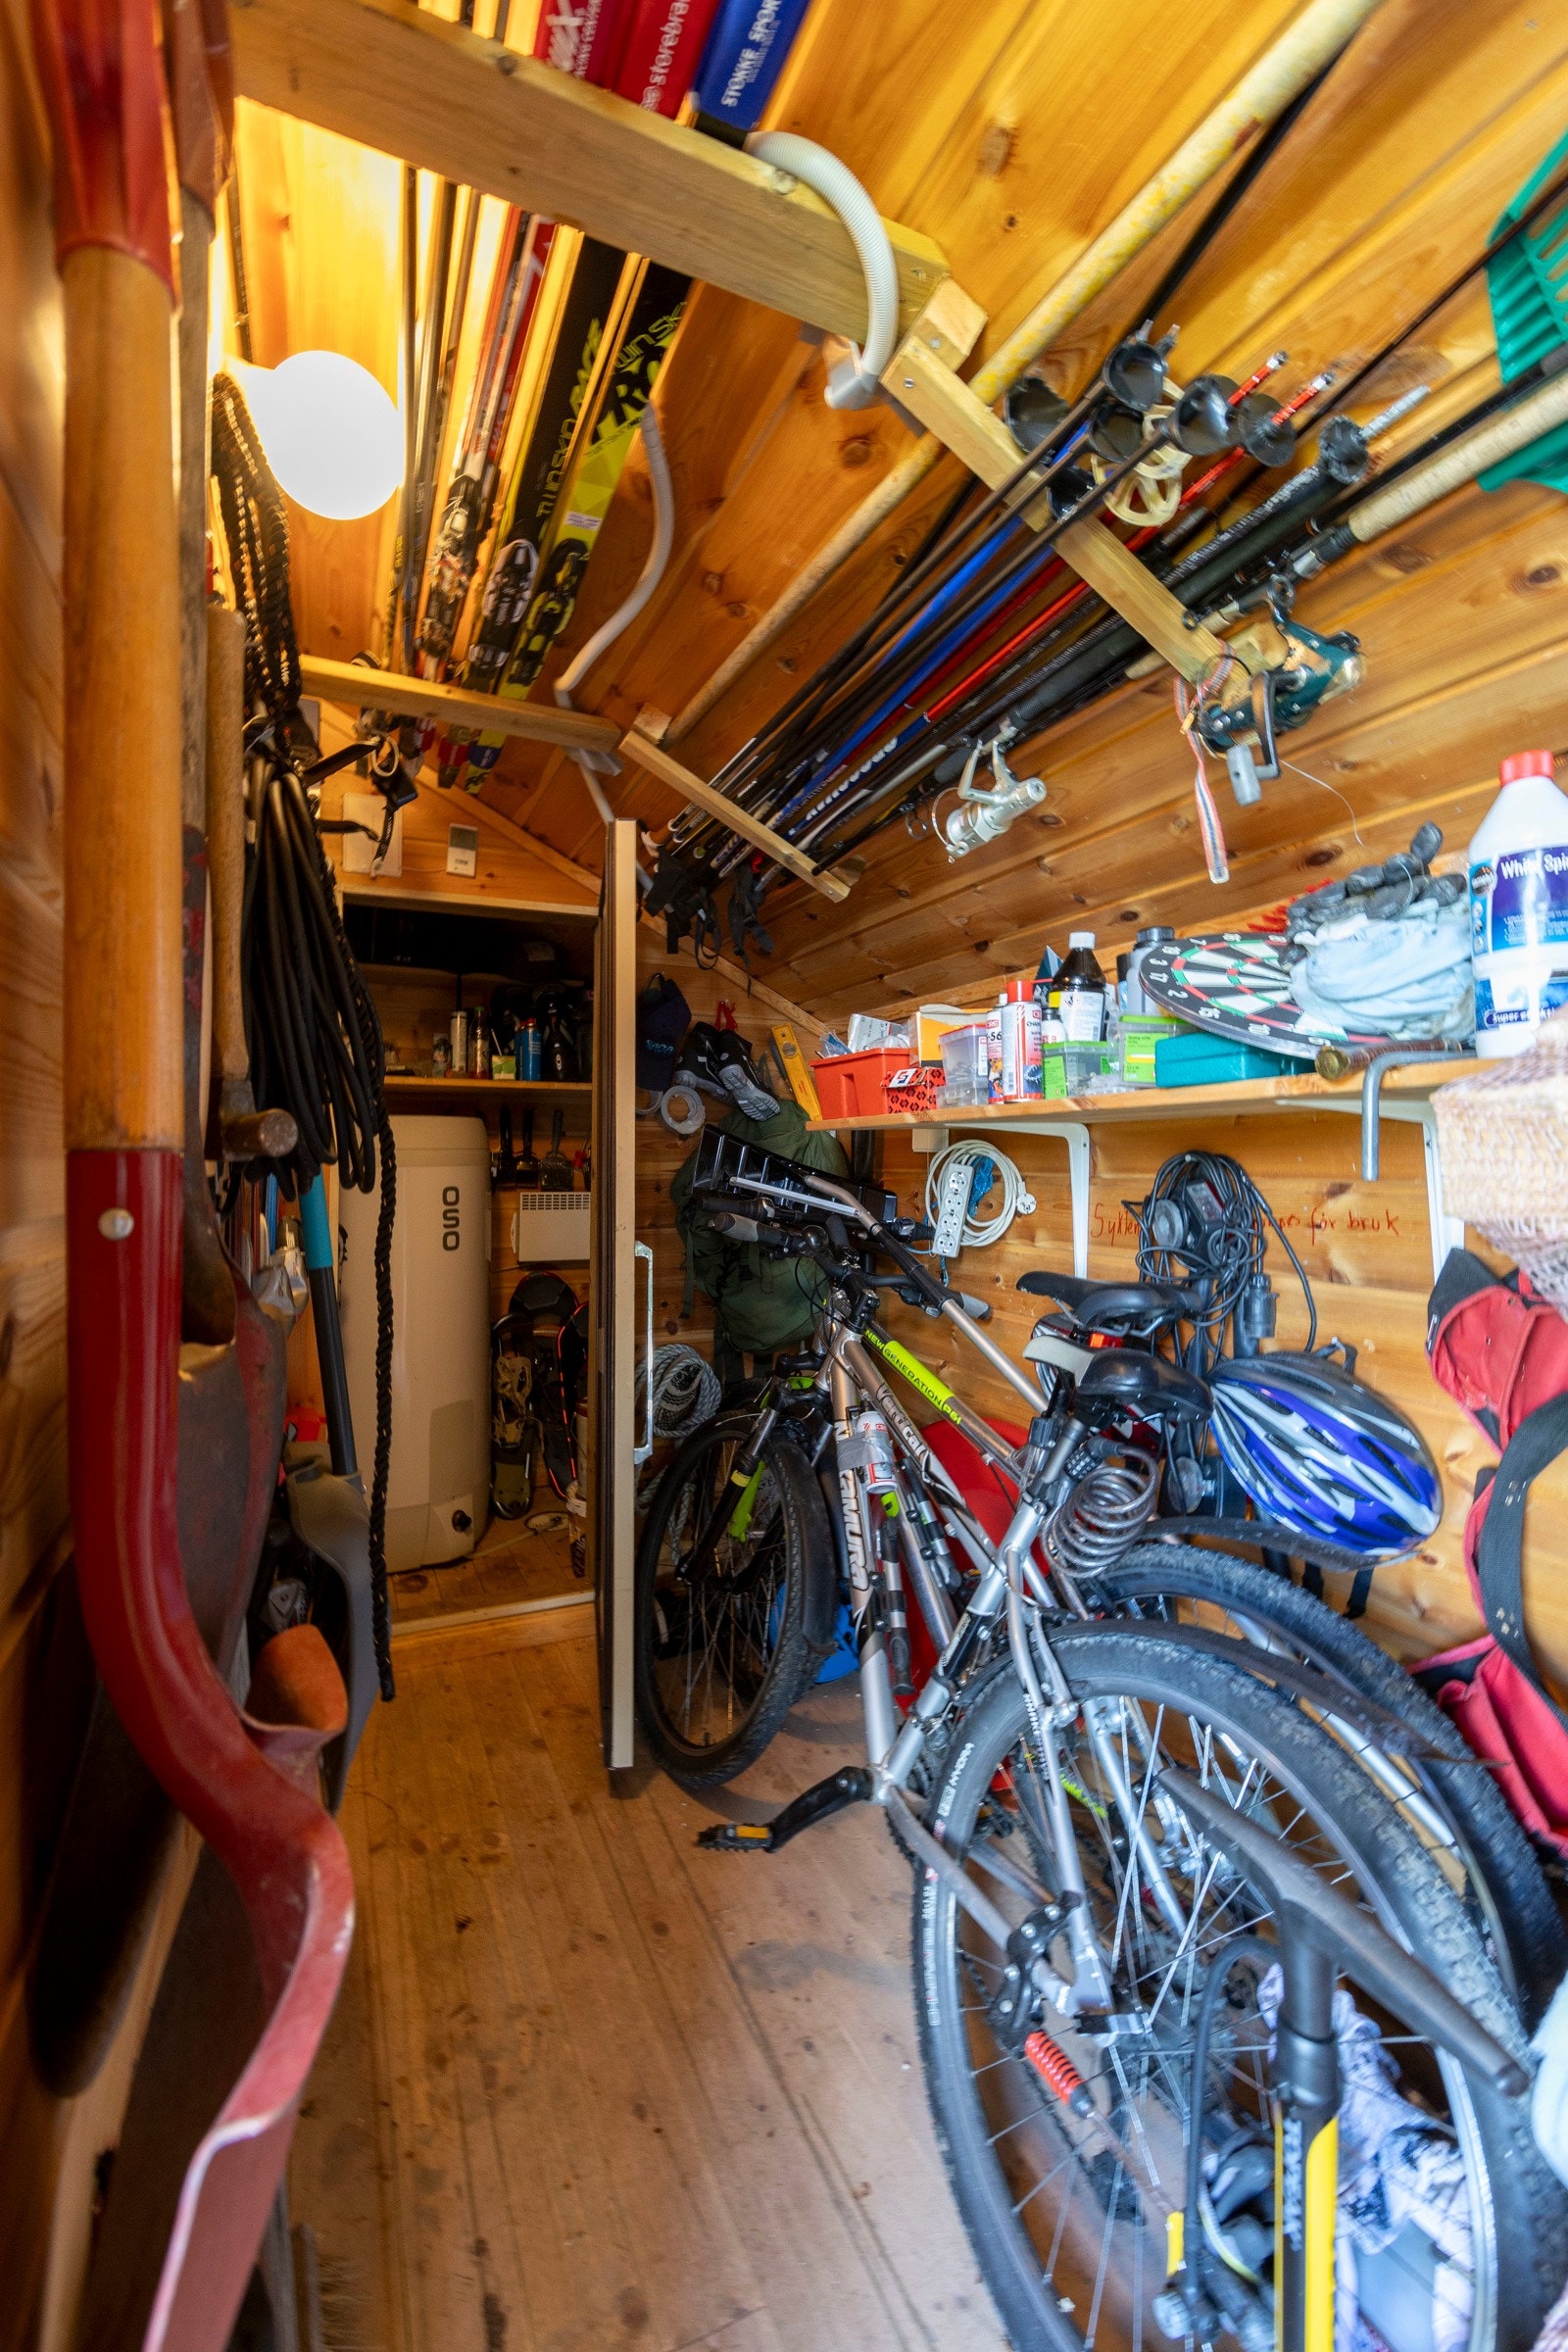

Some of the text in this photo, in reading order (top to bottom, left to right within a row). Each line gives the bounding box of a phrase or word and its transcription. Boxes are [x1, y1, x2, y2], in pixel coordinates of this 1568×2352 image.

[721, 48, 757, 107] STOKKE
[1500, 857, 1539, 880] Whit
[1149, 957, 1168, 966] 3
[1149, 971, 1169, 983] 17
[1166, 989, 1189, 1000] 2
[988, 1031, 1002, 1042] -56
[442, 1186, 461, 1251] OSO
[1348, 1209, 1400, 1238] bruk
[865, 1329, 885, 1350] NEW
[884, 1348, 942, 1406] GENERATION
[834, 1419, 869, 1591] NKAMURA
